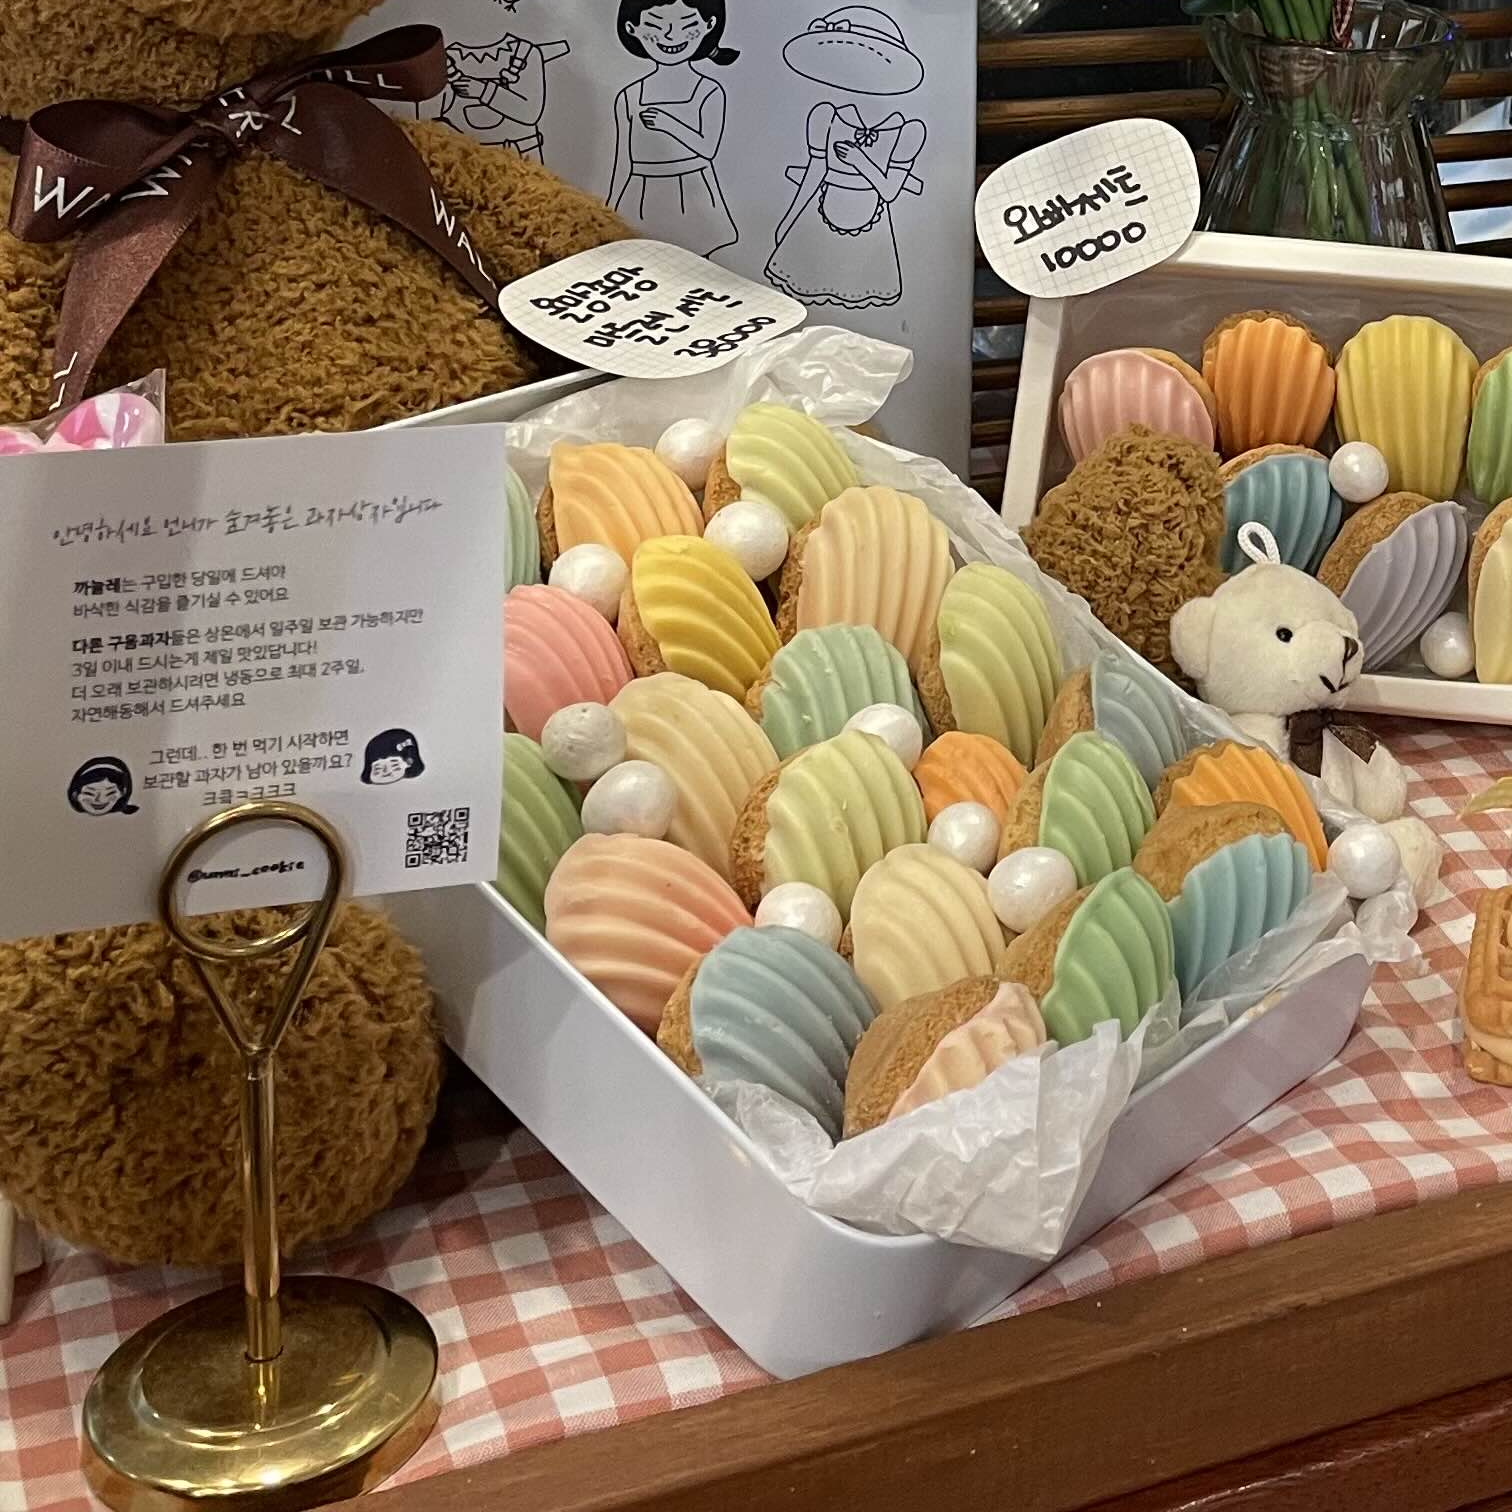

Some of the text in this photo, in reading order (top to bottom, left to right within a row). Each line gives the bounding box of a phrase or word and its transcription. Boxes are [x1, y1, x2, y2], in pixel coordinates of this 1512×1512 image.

[1003, 164, 1149, 245] 오빠세트
[1040, 221, 1147, 273] 10000
[675, 287, 743, 318] 세트
[53, 515, 159, 547] 안녕하세요
[163, 516, 219, 538] 언니가
[223, 504, 300, 536] 숨겨놓은
[73, 577, 138, 596] 까눌레는
[141, 571, 187, 591] 구입한
[191, 568, 236, 587] 당일에
[73, 601, 120, 619] 바삭한
[125, 596, 171, 615] 식감을
[225, 590, 241, 606] 수
[243, 586, 290, 605] 있어요
[72, 638, 103, 655] 다른
[204, 622, 265, 643] 상온에서
[269, 617, 313, 637] 일주일
[318, 614, 348, 632] 보관
[351, 608, 424, 629] 가능하지만
[72, 640, 318, 678] 3일 이내 드시는게 제일 맛있답니다!
[72, 684, 87, 700] 더
[91, 682, 122, 698] 오래
[127, 671, 219, 695] 보관하시려면
[223, 665, 283, 687] 냉동으로
[287, 663, 316, 679] 최대
[72, 701, 166, 723] 자연해동해서
[212, 742, 228, 760] 한
[233, 740, 249, 757] 번
[252, 735, 282, 754] 먹기
[286, 729, 350, 749] 시작하면
[143, 752, 353, 790] 보관할 과자가 남아 있을까요?
